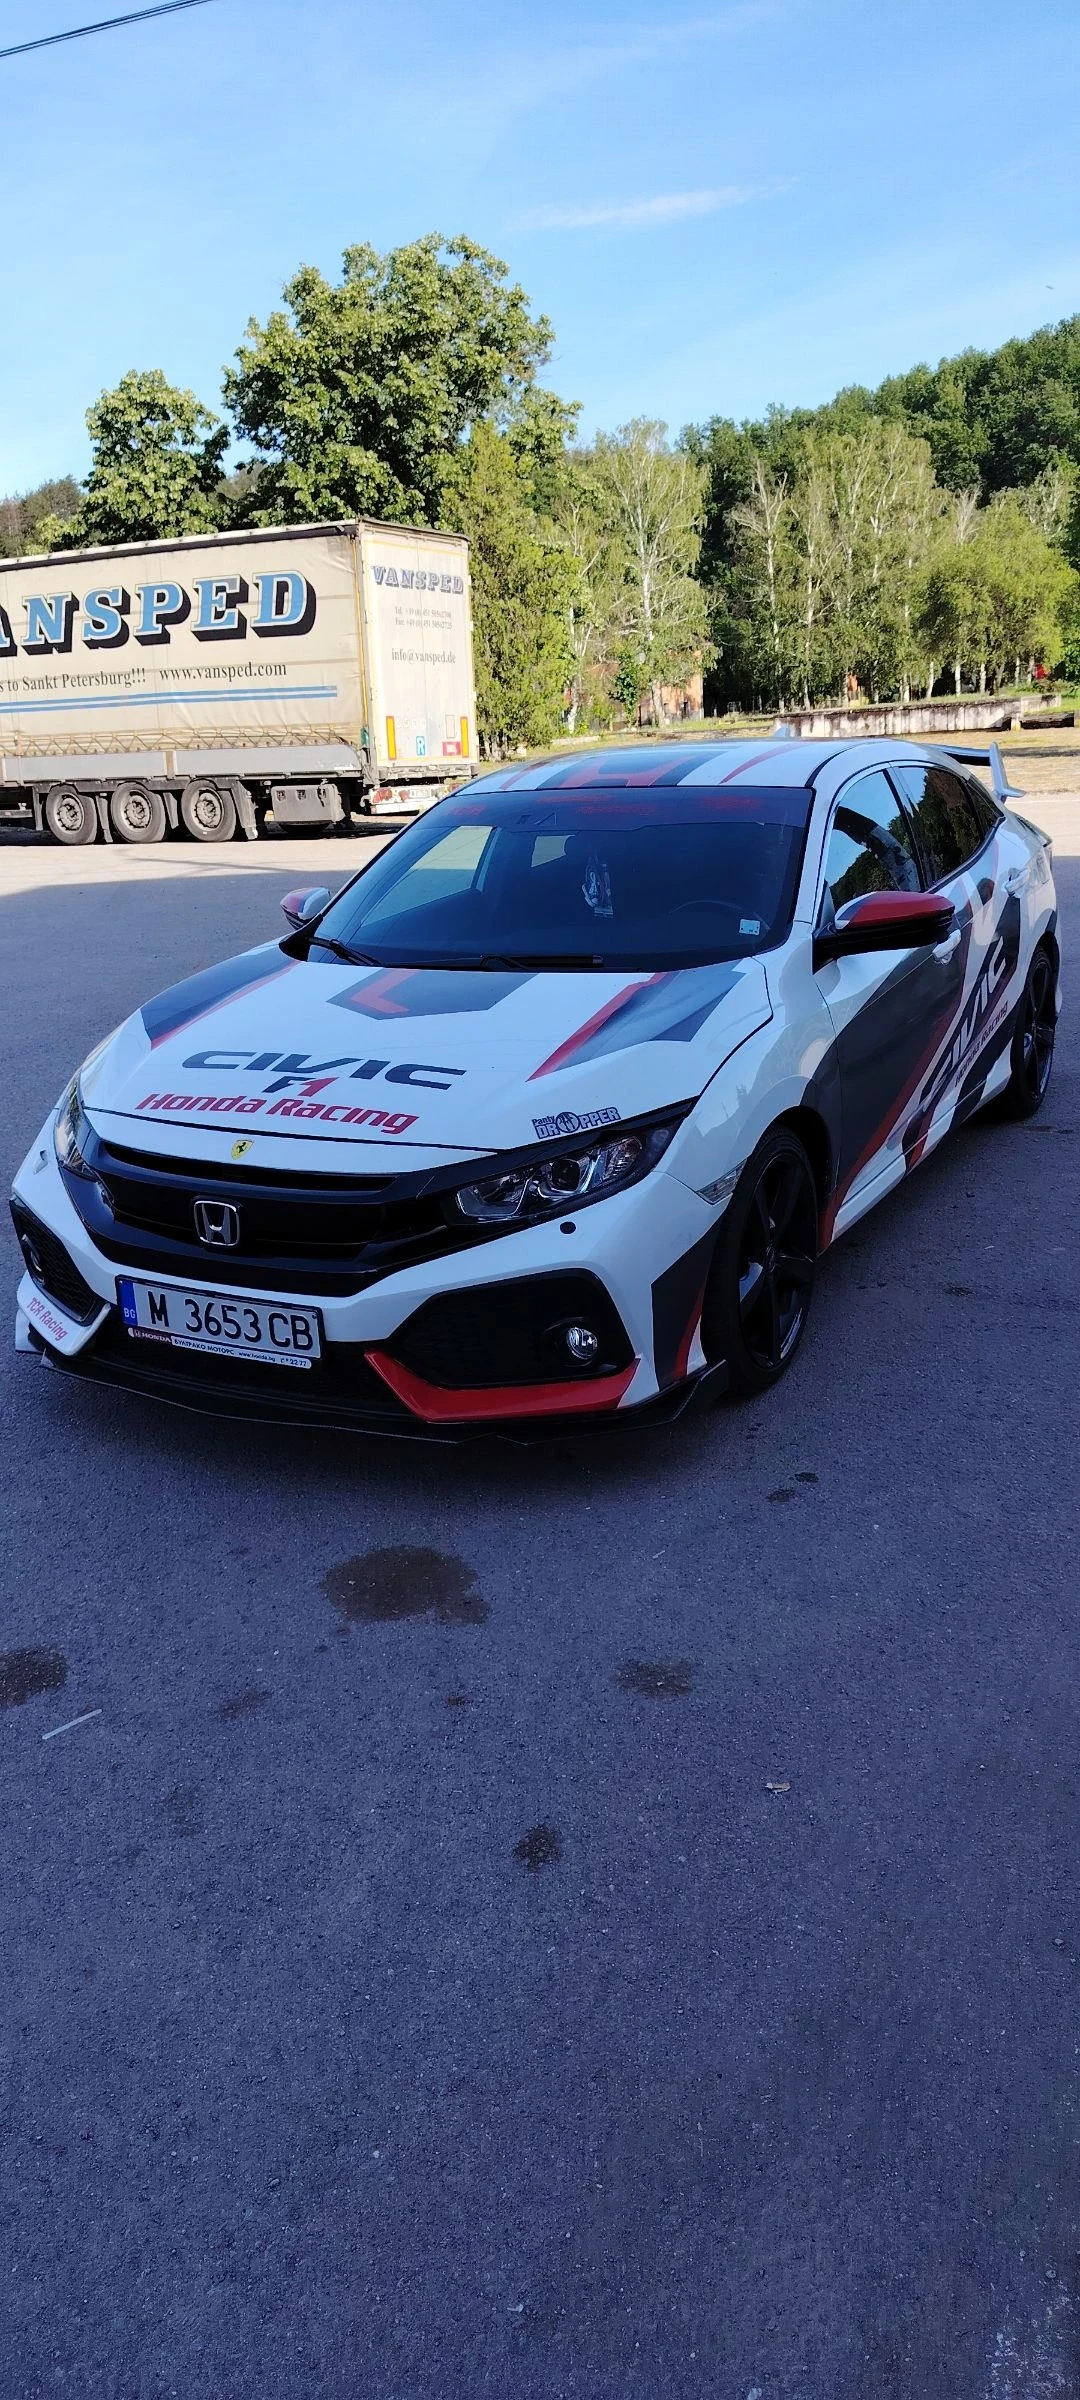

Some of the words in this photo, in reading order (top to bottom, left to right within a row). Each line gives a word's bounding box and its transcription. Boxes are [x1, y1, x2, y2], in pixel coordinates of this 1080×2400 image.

[372, 566, 464, 594] VANSPED
[391, 648, 456, 666] info@vansped.de
[8, 679, 19, 691] to
[22, 674, 58, 691] Sankt
[61, 668, 146, 689] Petersburg!!!
[160, 662, 287, 682] www.vansped.com
[182, 1051, 467, 1090] CIVIC
[135, 1093, 267, 1114] Honda
[266, 1099, 420, 1135] Racing
[532, 1115, 557, 1127] Panty
[27, 1297, 45, 1317] TCR
[39, 1310, 68, 1341] Racing
[124, 1308, 136, 1319] BG
[147, 1291, 169, 1327] M
[185, 1299, 262, 1343] 3653
[268, 1313, 313, 1351] CB
[141, 1332, 172, 1342] HONDA
